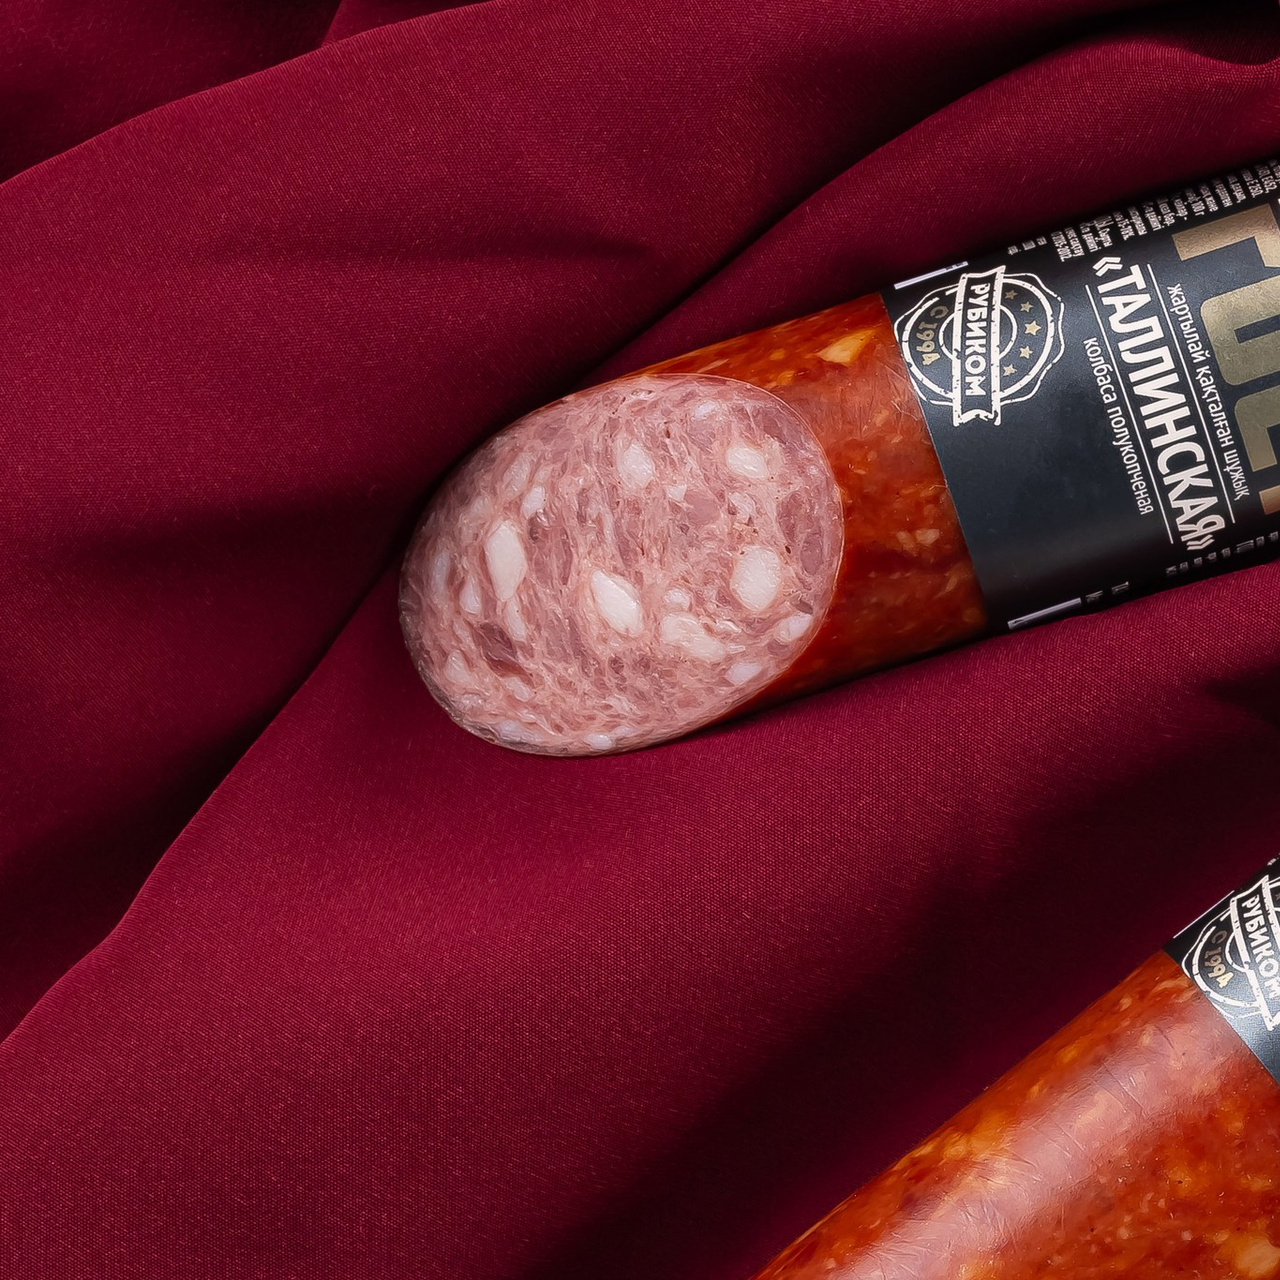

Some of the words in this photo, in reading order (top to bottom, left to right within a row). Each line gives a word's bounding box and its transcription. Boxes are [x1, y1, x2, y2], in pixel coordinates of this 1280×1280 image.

[916, 322, 941, 367] 1994
[964, 282, 992, 397] РУБИКОМ
[1166, 283, 1211, 363] жартылай
[1083, 337, 1118, 405] колбаса
[1107, 406, 1154, 516] полукопченая
[1092, 256, 1226, 551] «ТАЛЛИНСКАЯ»
[1203, 946, 1235, 989] 1994
